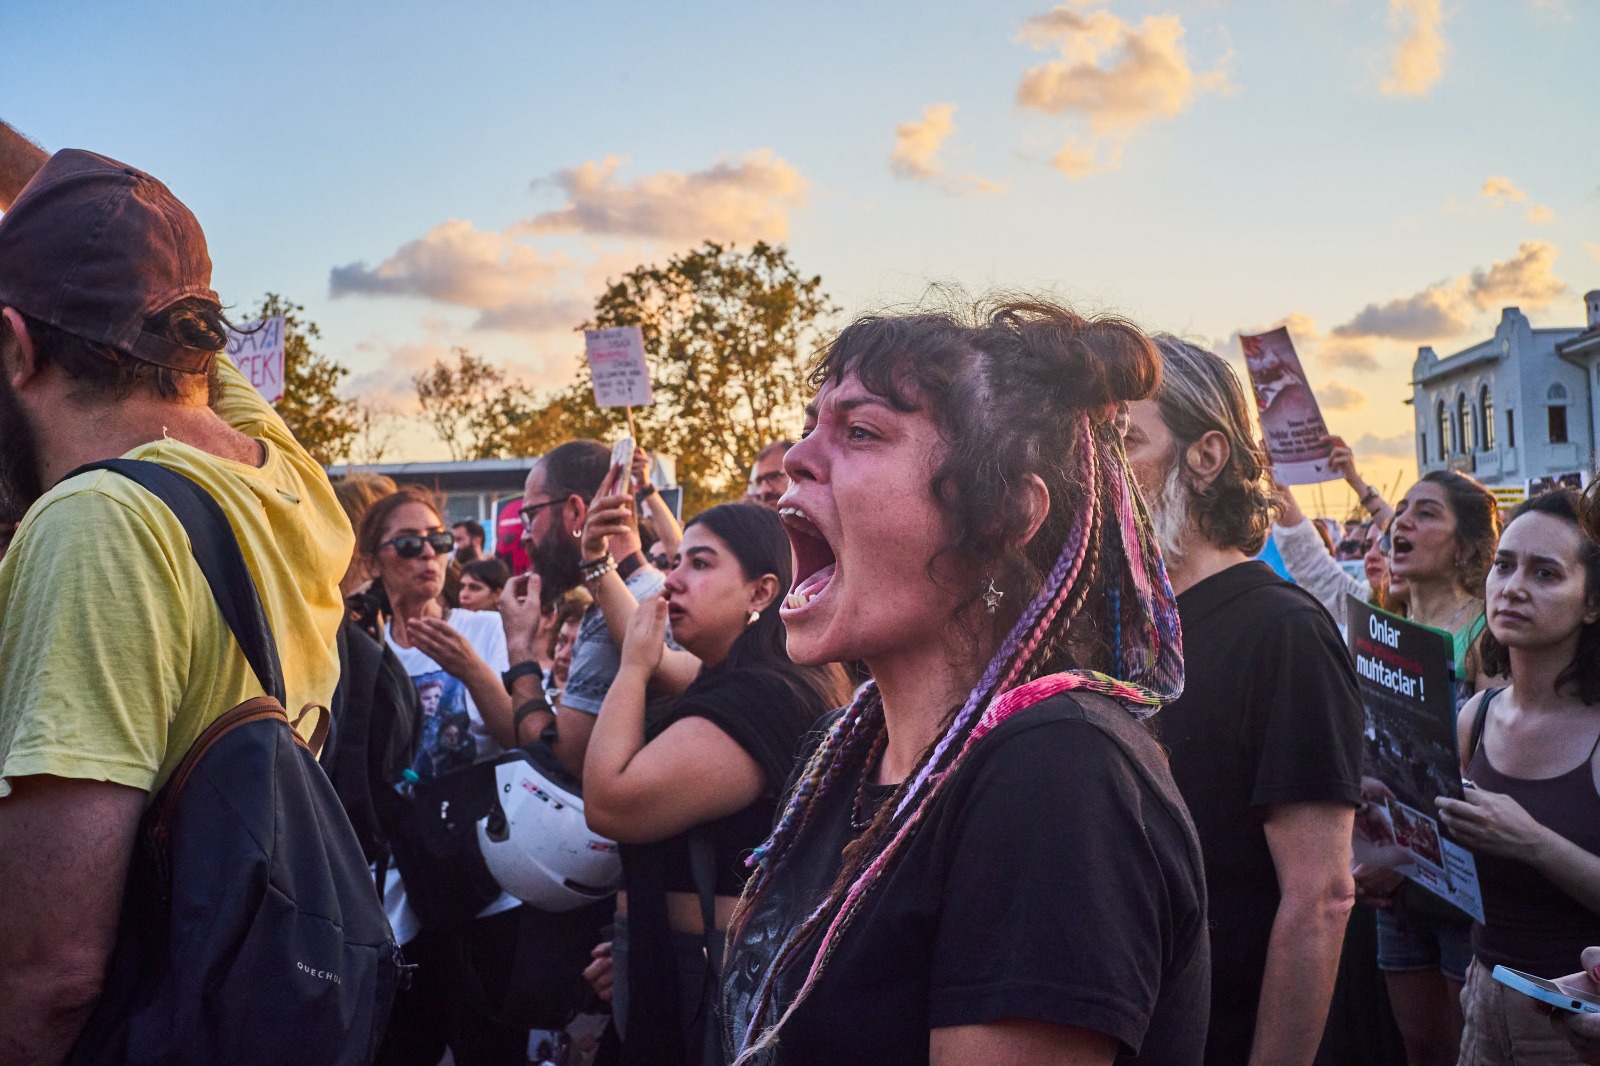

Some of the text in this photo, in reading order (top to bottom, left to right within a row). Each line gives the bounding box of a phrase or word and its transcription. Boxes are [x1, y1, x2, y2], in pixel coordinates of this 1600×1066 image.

[1369, 613, 1401, 649] Onlar
[1356, 653, 1417, 698] muhtaçlar
[1419, 676, 1425, 702] !
